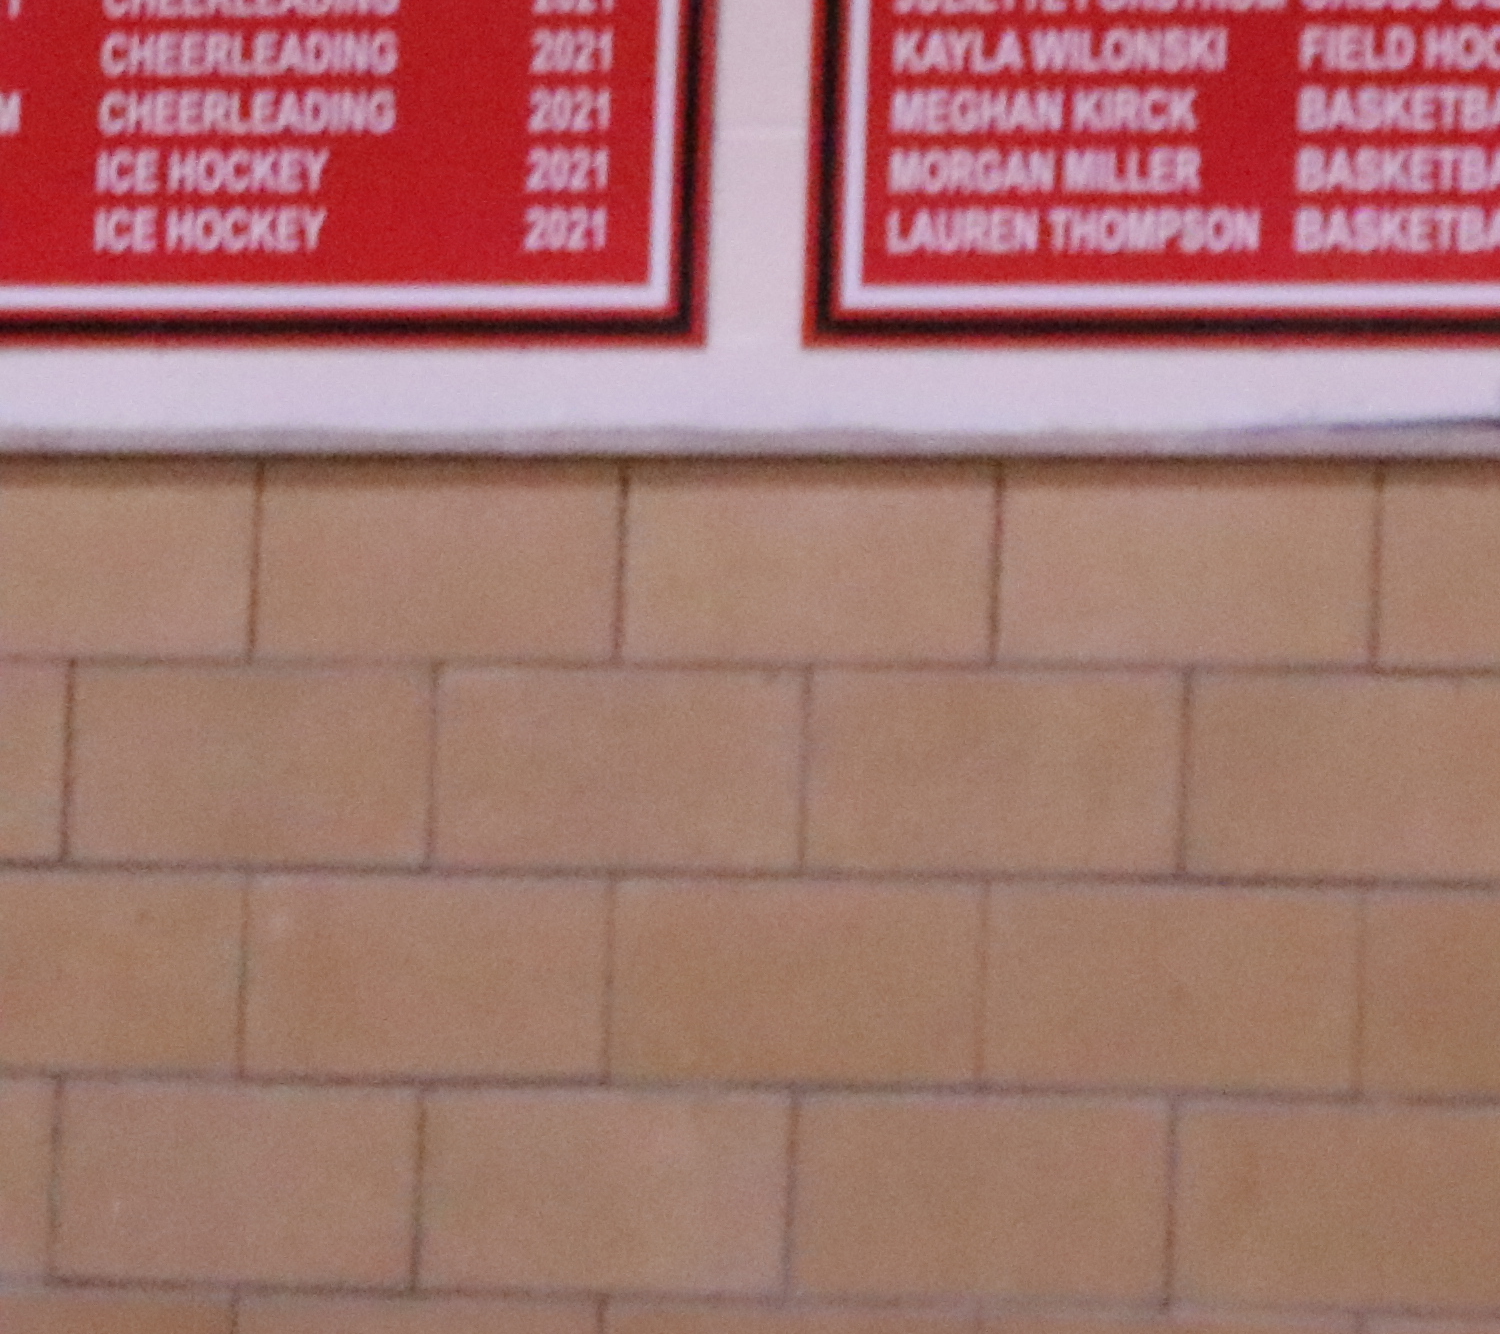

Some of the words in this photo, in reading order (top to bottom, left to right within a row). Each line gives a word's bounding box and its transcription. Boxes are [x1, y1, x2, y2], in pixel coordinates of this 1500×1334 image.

[893, 29, 1024, 73] KAYLA
[1031, 26, 1227, 73] WILONSKI
[1299, 25, 1416, 72] FIELD
[98, 89, 396, 135] CHEERLEADING
[528, 87, 611, 133] 2021
[890, 88, 1063, 134] MEGHAN
[1072, 86, 1197, 132] KIRCK
[96, 149, 158, 194] ICE
[168, 148, 328, 193] HOCKEY
[526, 147, 608, 192] 2021
[888, 148, 1055, 194] MORGAN
[1063, 146, 1201, 193] MILLER
[94, 207, 156, 253] ICE
[166, 207, 326, 252] HOCKEY
[524, 206, 607, 252] 2021
[886, 207, 1039, 254] LAUREN
[1048, 206, 1261, 253] THOMPSON
